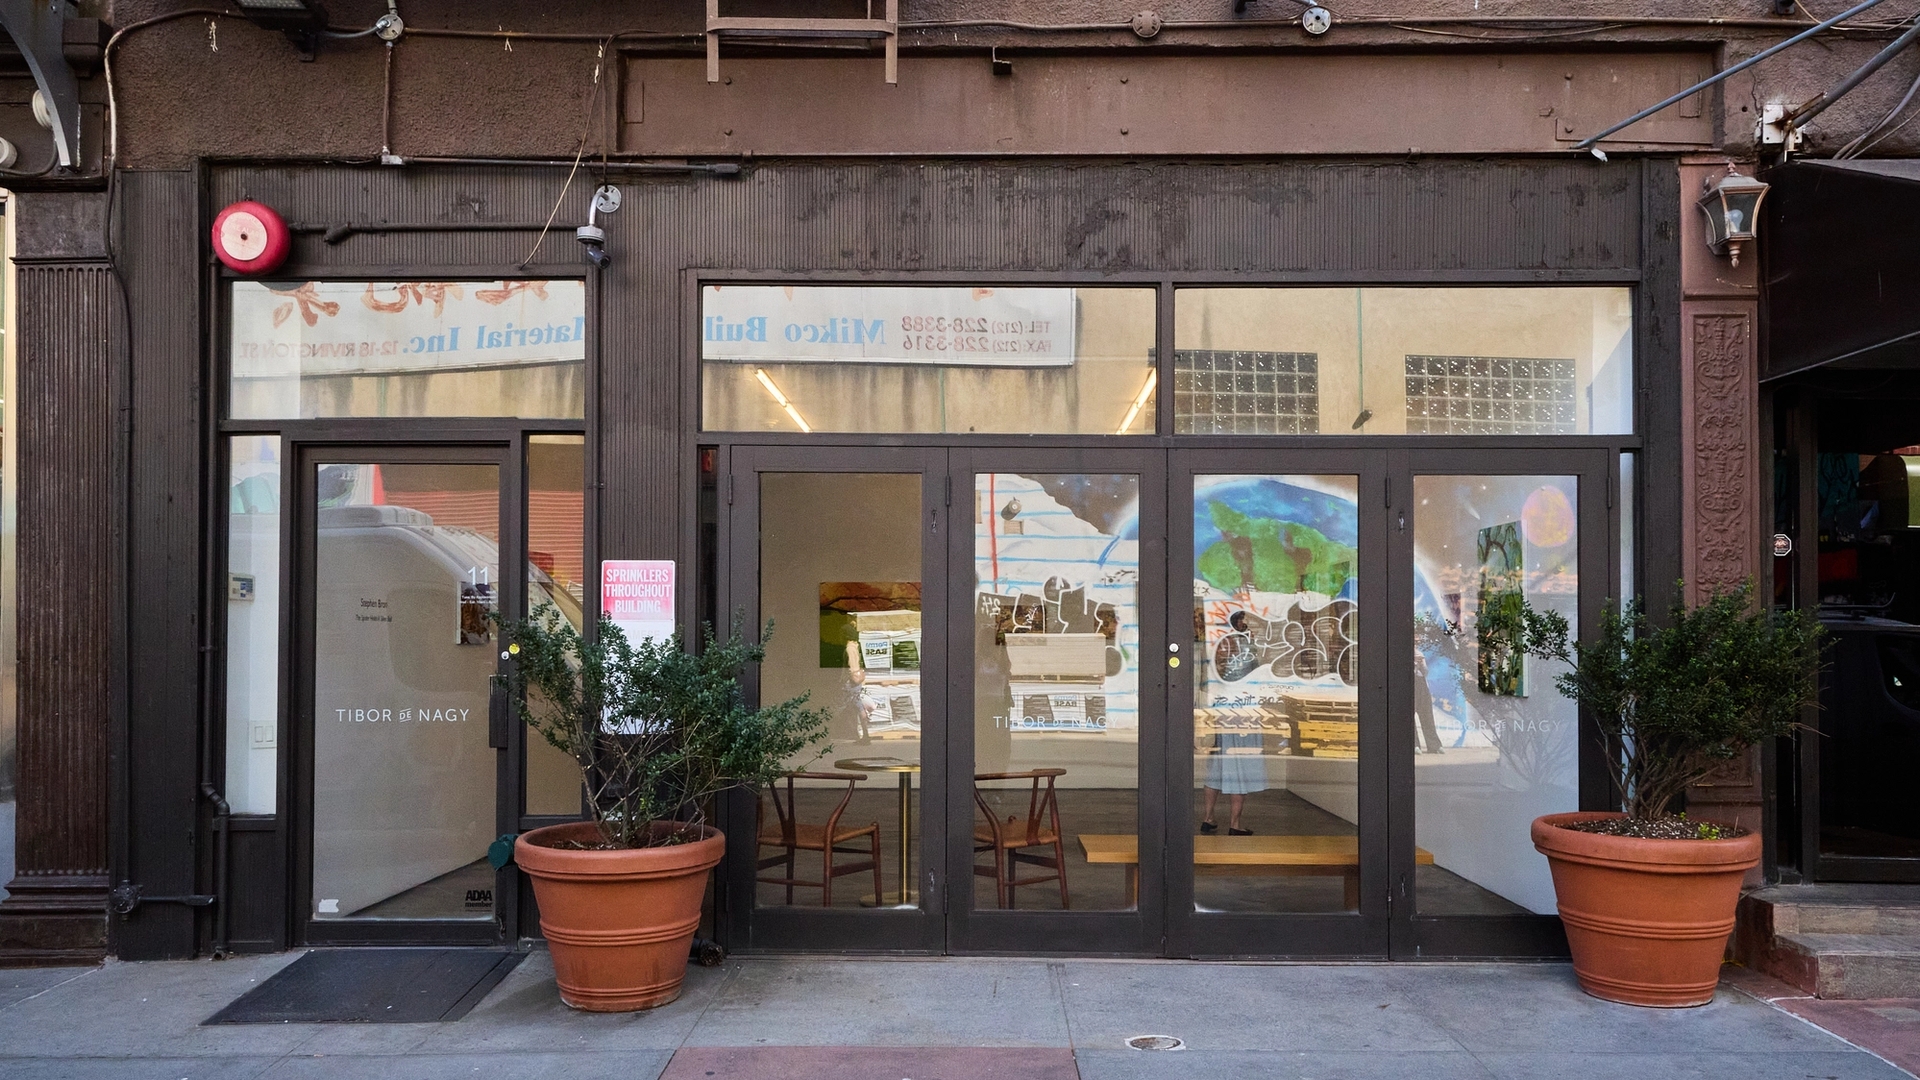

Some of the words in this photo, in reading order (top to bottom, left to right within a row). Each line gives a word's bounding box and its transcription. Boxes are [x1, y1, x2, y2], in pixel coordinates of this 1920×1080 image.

[467, 566, 489, 586] 11
[606, 568, 669, 582] SPRINKLERS
[604, 584, 672, 597] THROUGHOUT
[614, 599, 661, 613] BUILDING
[335, 708, 392, 722] TIBOR
[399, 708, 412, 722] DE
[418, 708, 470, 722] NAGY
[993, 715, 1046, 729] TIBOR
[1070, 715, 1120, 729] NAGY
[1513, 719, 1562, 733] NAGY
[465, 890, 493, 901] ADAA
